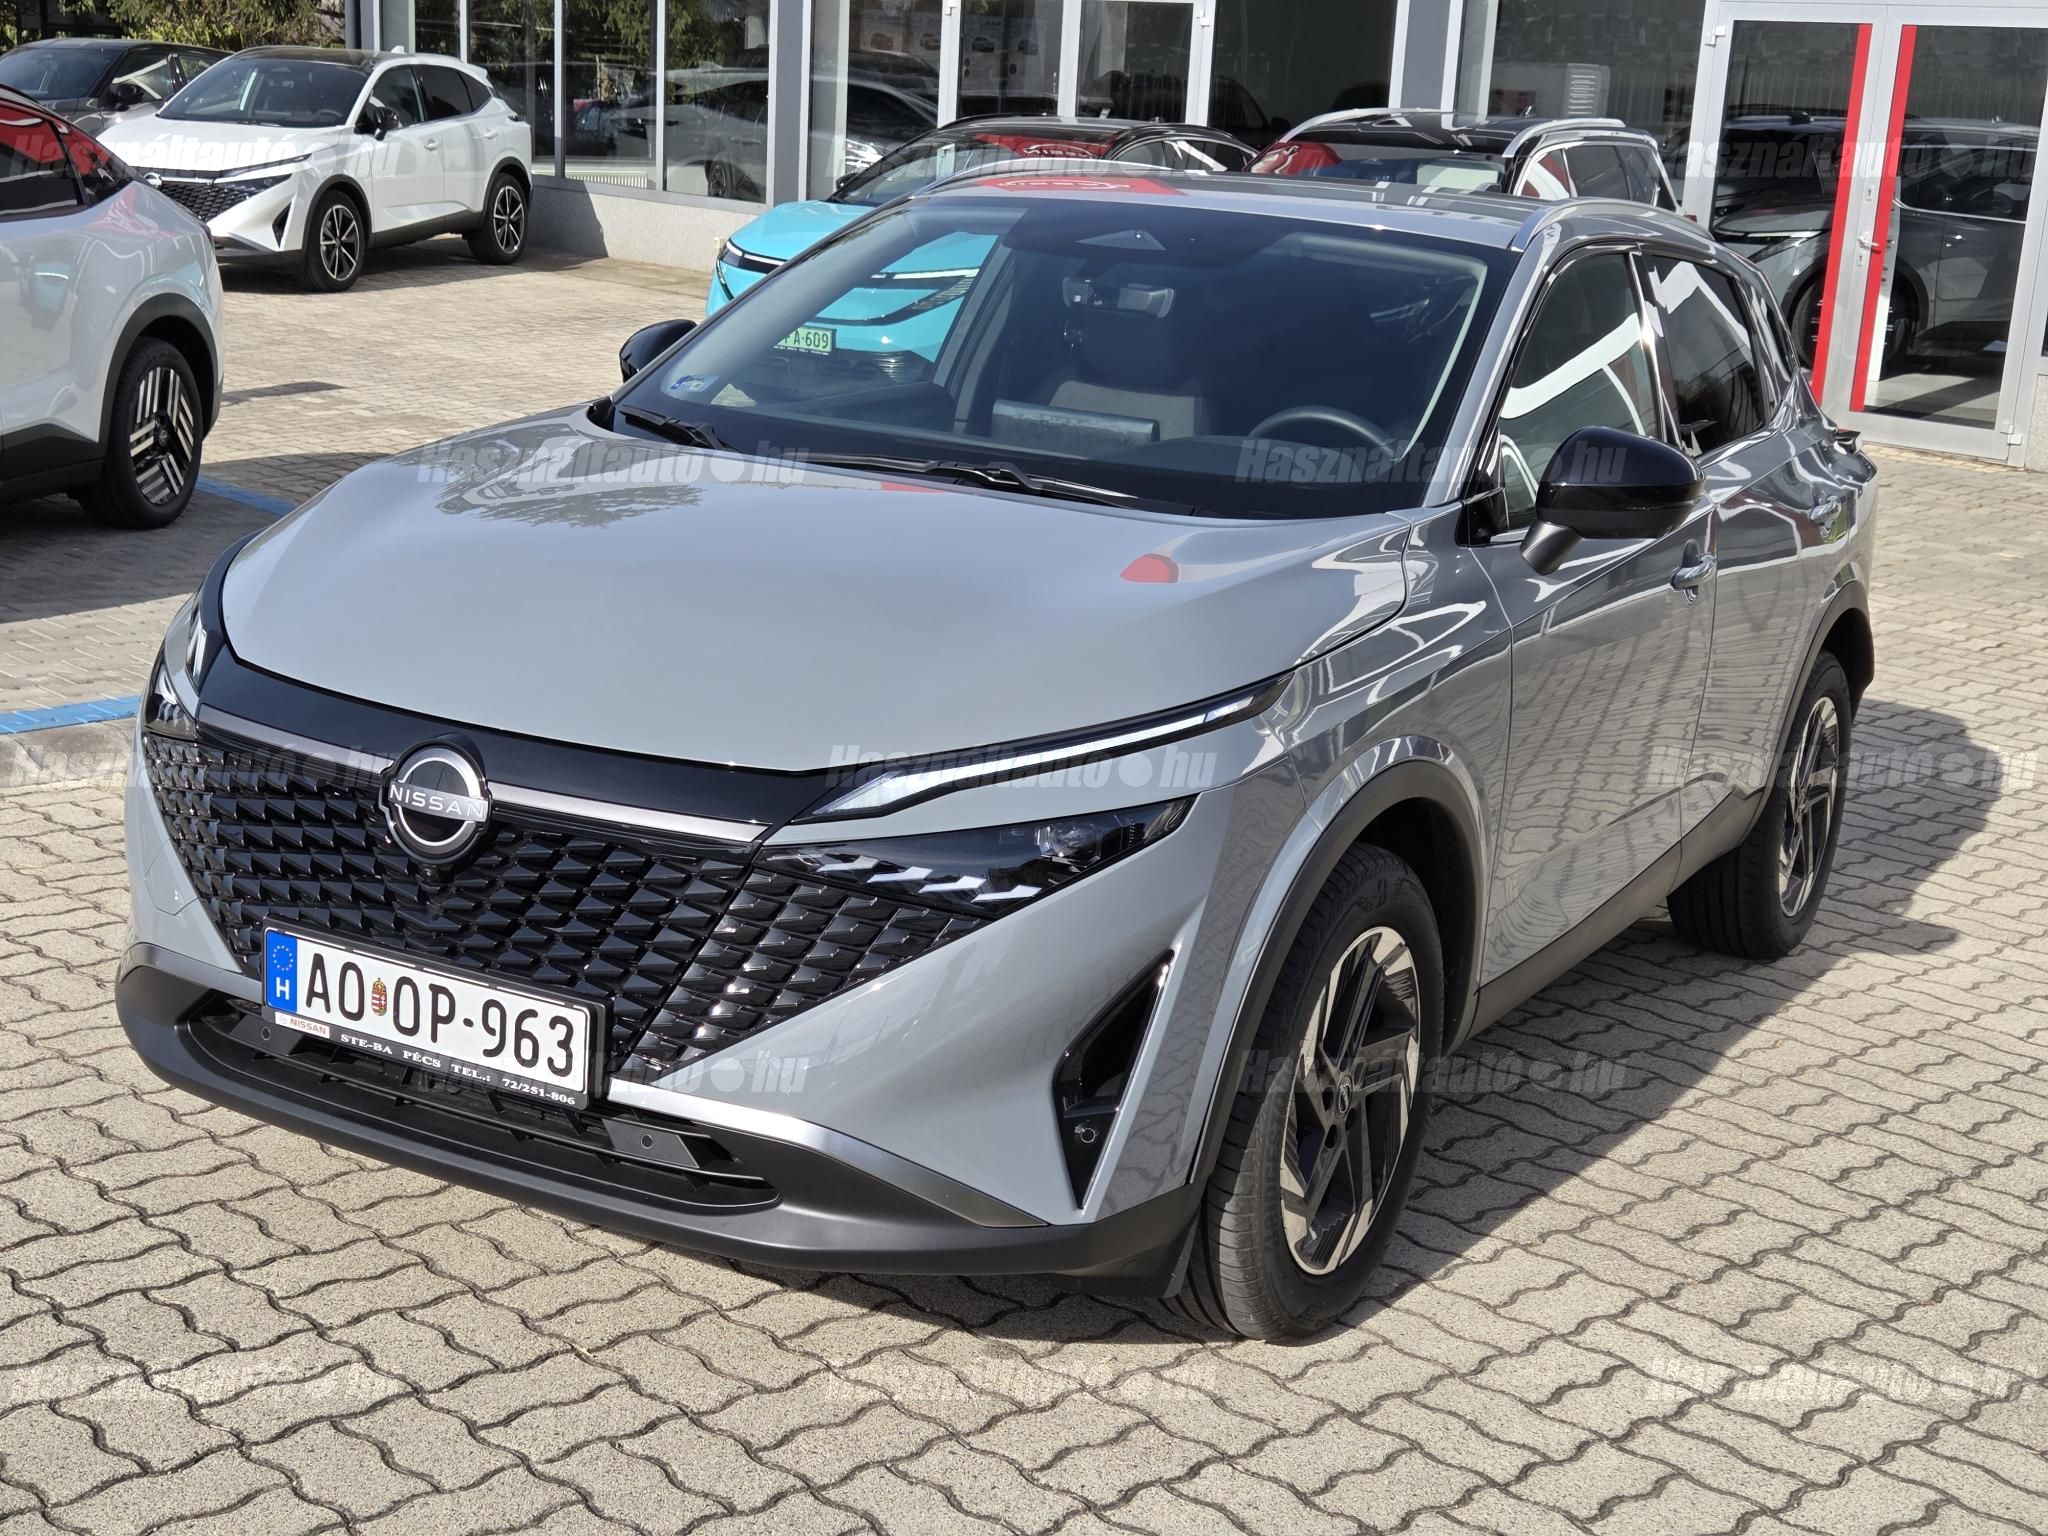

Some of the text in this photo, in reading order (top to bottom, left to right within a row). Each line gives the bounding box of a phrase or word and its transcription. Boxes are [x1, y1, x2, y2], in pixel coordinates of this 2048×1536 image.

[389, 784, 485, 818] NISSAN
[275, 977, 290, 1001] H
[290, 1018, 327, 1035] NISSAN
[305, 952, 575, 1078] AO OP-963
[340, 1033, 576, 1106] STE-BA PÉCS TEL.: 72/251-806
